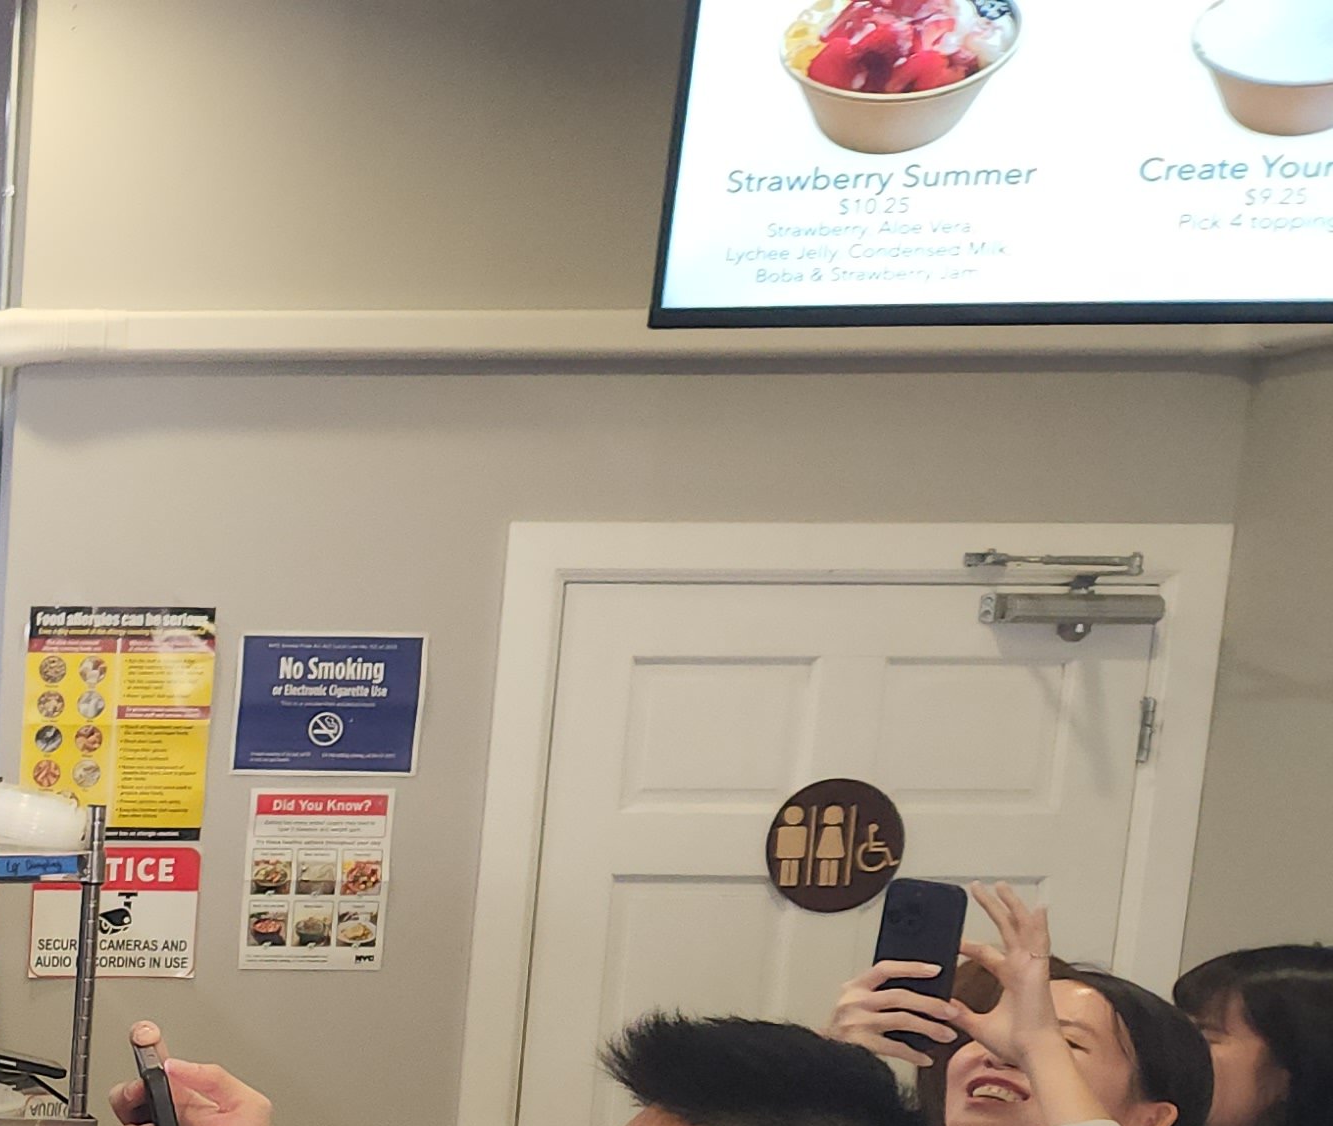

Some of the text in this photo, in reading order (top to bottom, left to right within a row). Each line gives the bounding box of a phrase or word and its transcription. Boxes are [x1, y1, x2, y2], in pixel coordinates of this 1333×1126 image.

[1139, 153, 1333, 182] Create Your
[726, 164, 1037, 196] Strawberry Summer
[838, 196, 910, 215] $10.25
[878, 221, 923, 235] Aloe
[1179, 213, 1243, 231] Pick 4
[725, 243, 962, 266] Lychee Condensed
[755, 267, 805, 284] Boba
[36, 612, 66, 627] Food
[66, 612, 120, 628] allergies
[121, 614, 144, 627] can
[145, 613, 162, 626] be
[278, 656, 386, 684] No Smoking
[271, 684, 388, 699] or Electronic Cigarette Use
[272, 799, 372, 812] Did You Know?
[106, 857, 176, 883] TICE
[37, 938, 188, 952] SECUR CAMERAS AND
[35, 955, 190, 970] AUDIO CORDING IN USE
